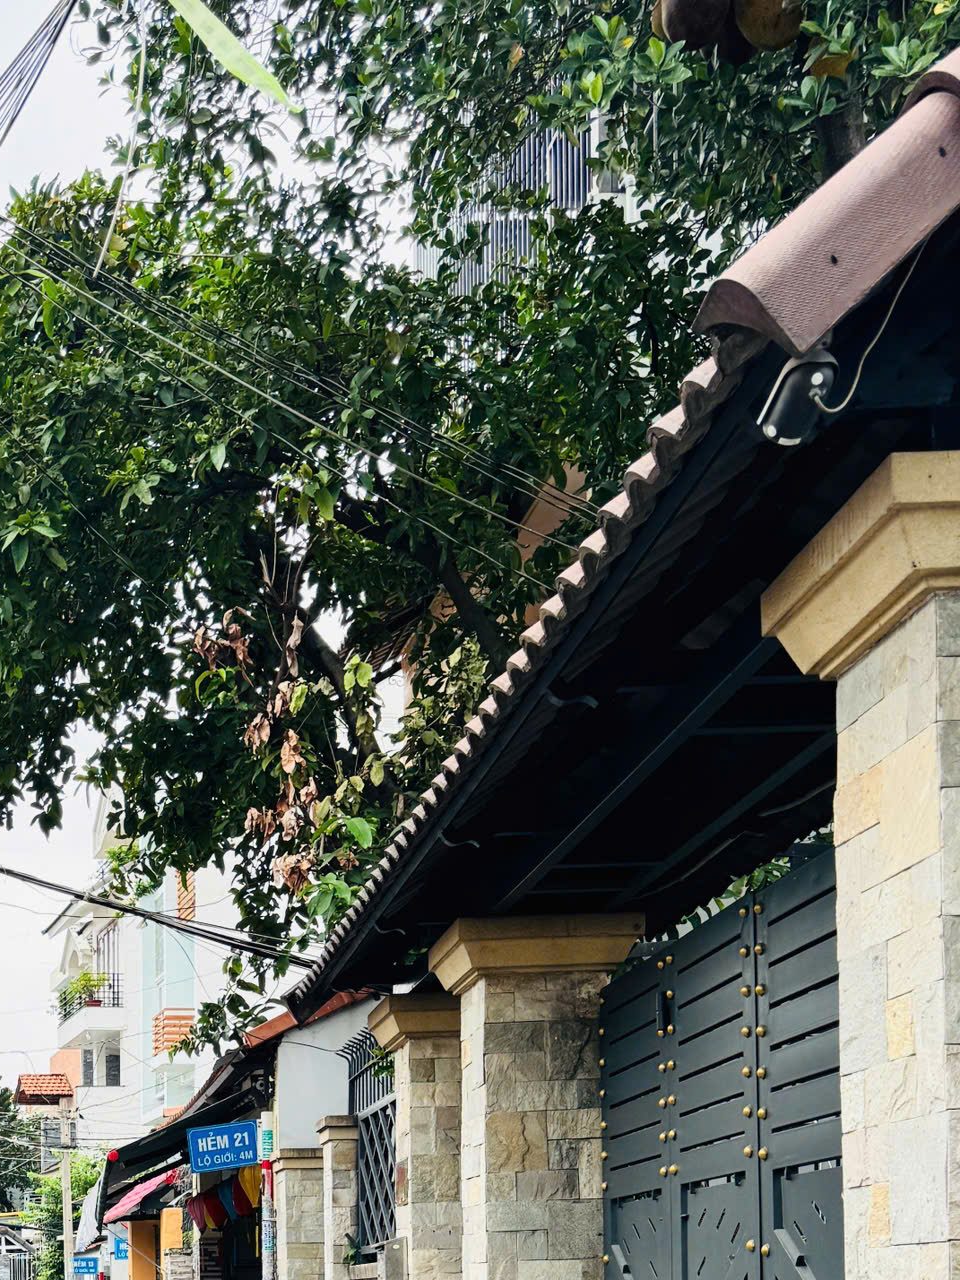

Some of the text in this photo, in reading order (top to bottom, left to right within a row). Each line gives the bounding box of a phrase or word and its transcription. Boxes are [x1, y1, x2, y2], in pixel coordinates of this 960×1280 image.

[197, 1132, 229, 1152] HẺM
[234, 1131, 249, 1147] 21
[198, 1150, 253, 1167] LỘ GIỚI: 4M
